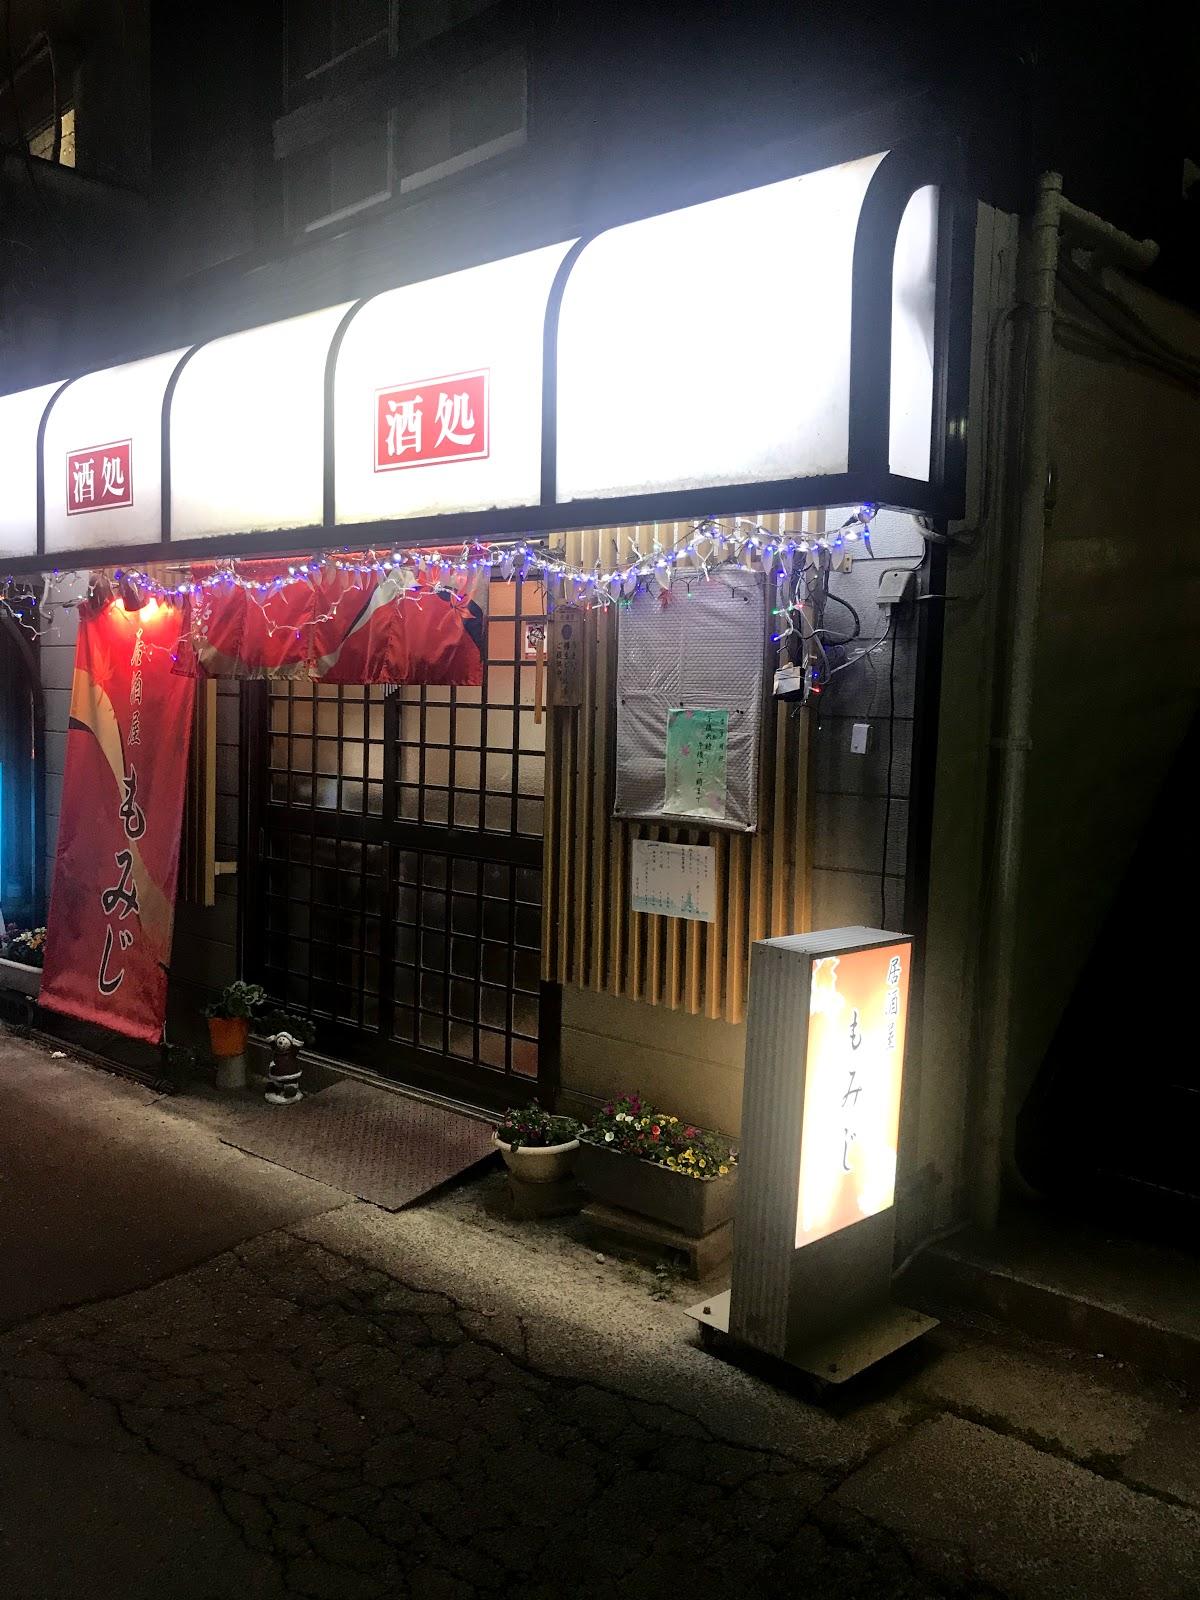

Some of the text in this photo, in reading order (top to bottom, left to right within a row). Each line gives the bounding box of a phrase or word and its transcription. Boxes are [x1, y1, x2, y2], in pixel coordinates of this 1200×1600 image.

[72, 455, 126, 503] 酒処
[385, 392, 475, 456] 酒処
[98, 763, 147, 997] もみじ
[841, 1009, 863, 1172] もみじ
